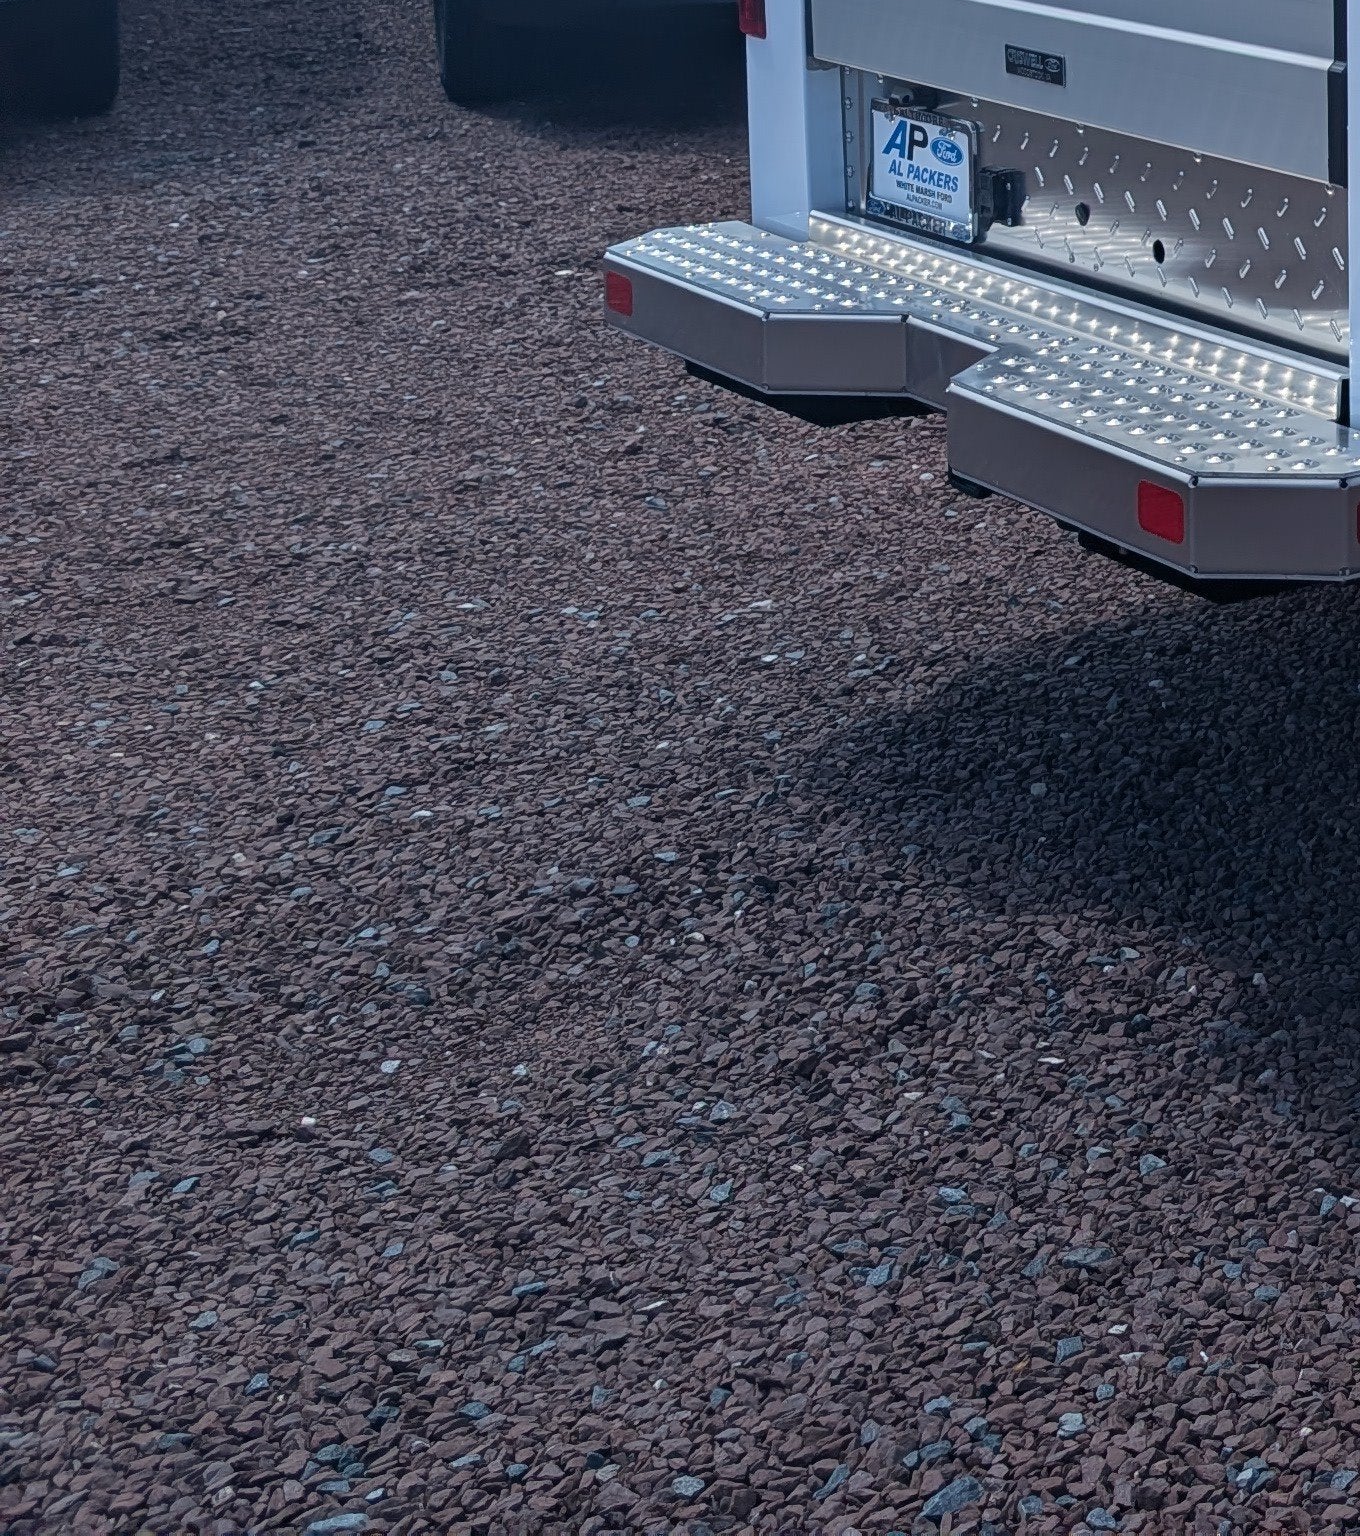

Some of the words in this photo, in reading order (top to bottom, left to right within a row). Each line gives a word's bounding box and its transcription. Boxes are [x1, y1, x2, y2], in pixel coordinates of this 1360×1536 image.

[882, 119, 929, 161] AP
[934, 139, 961, 164] Ford
[888, 159, 904, 177] AL
[907, 164, 959, 193] PACKERS
[915, 184, 936, 199] MARSH
[936, 191, 953, 204] FORD
